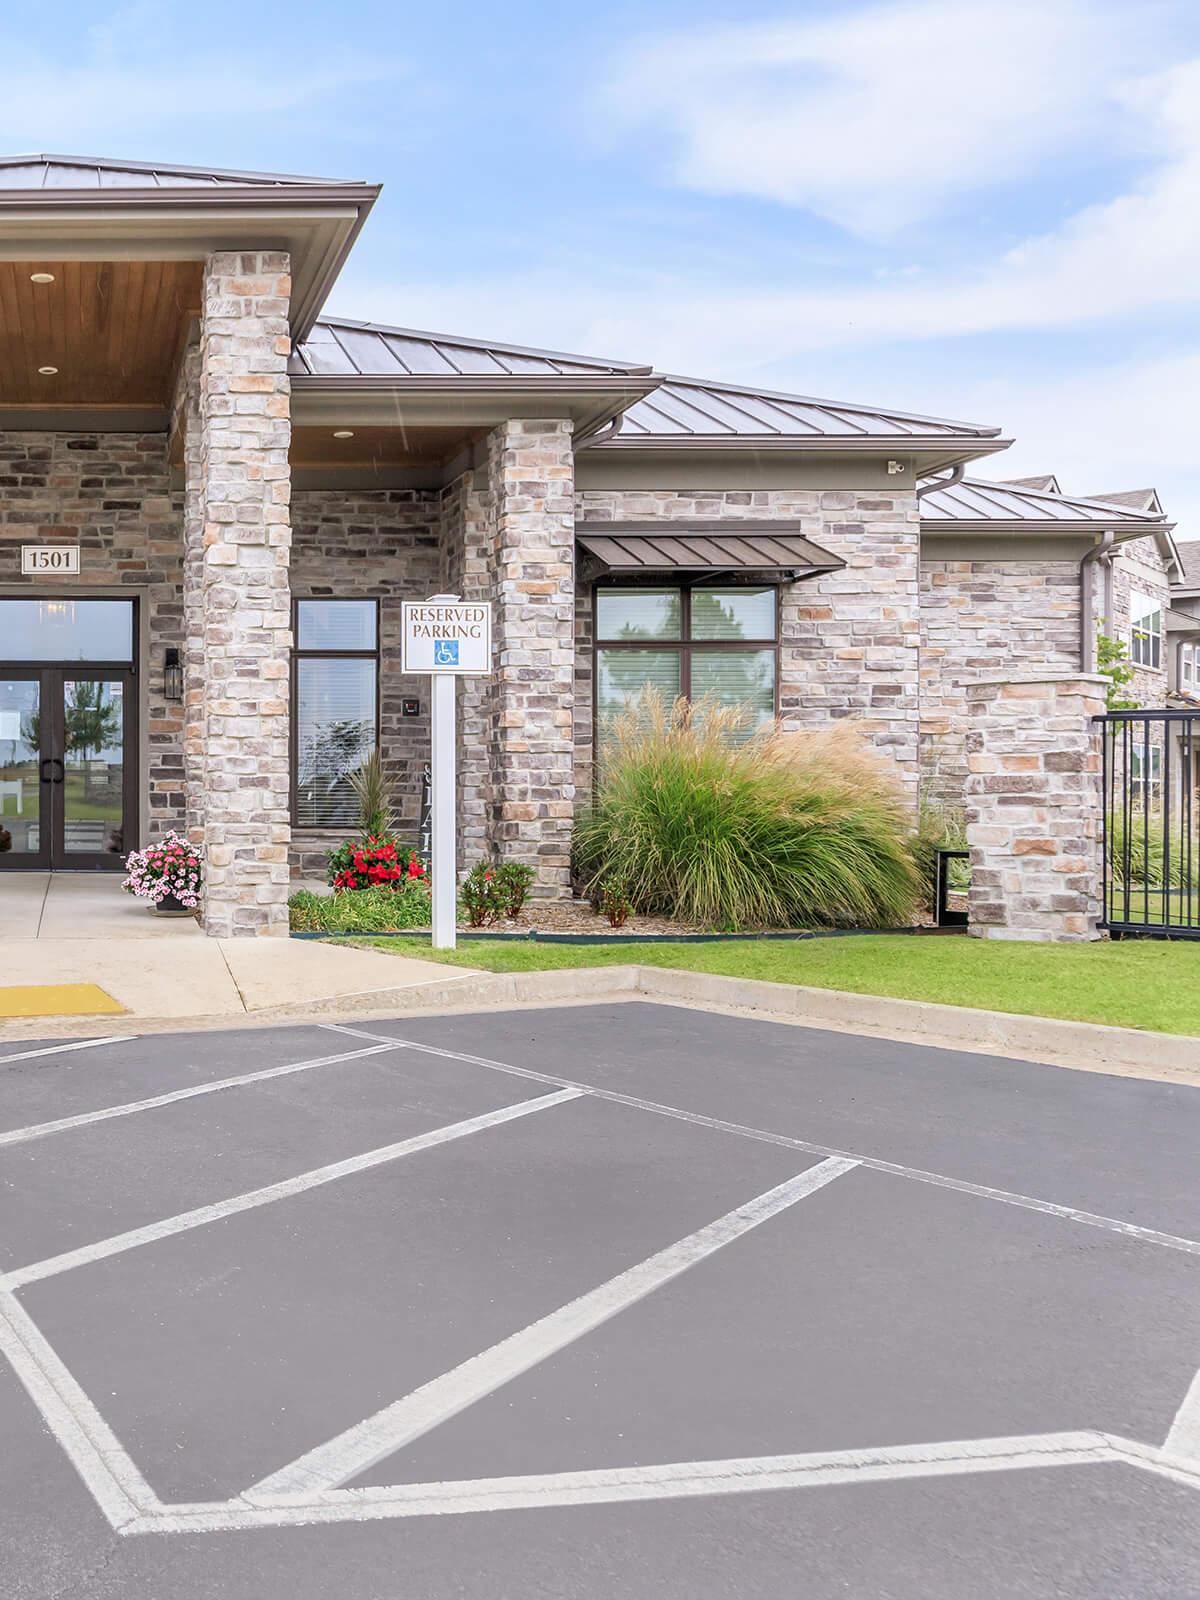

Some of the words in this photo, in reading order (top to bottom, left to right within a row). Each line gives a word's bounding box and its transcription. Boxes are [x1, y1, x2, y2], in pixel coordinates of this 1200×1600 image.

[29, 551, 70, 568] 1501
[410, 608, 485, 622] RESERVED
[413, 624, 481, 639] PARKING
